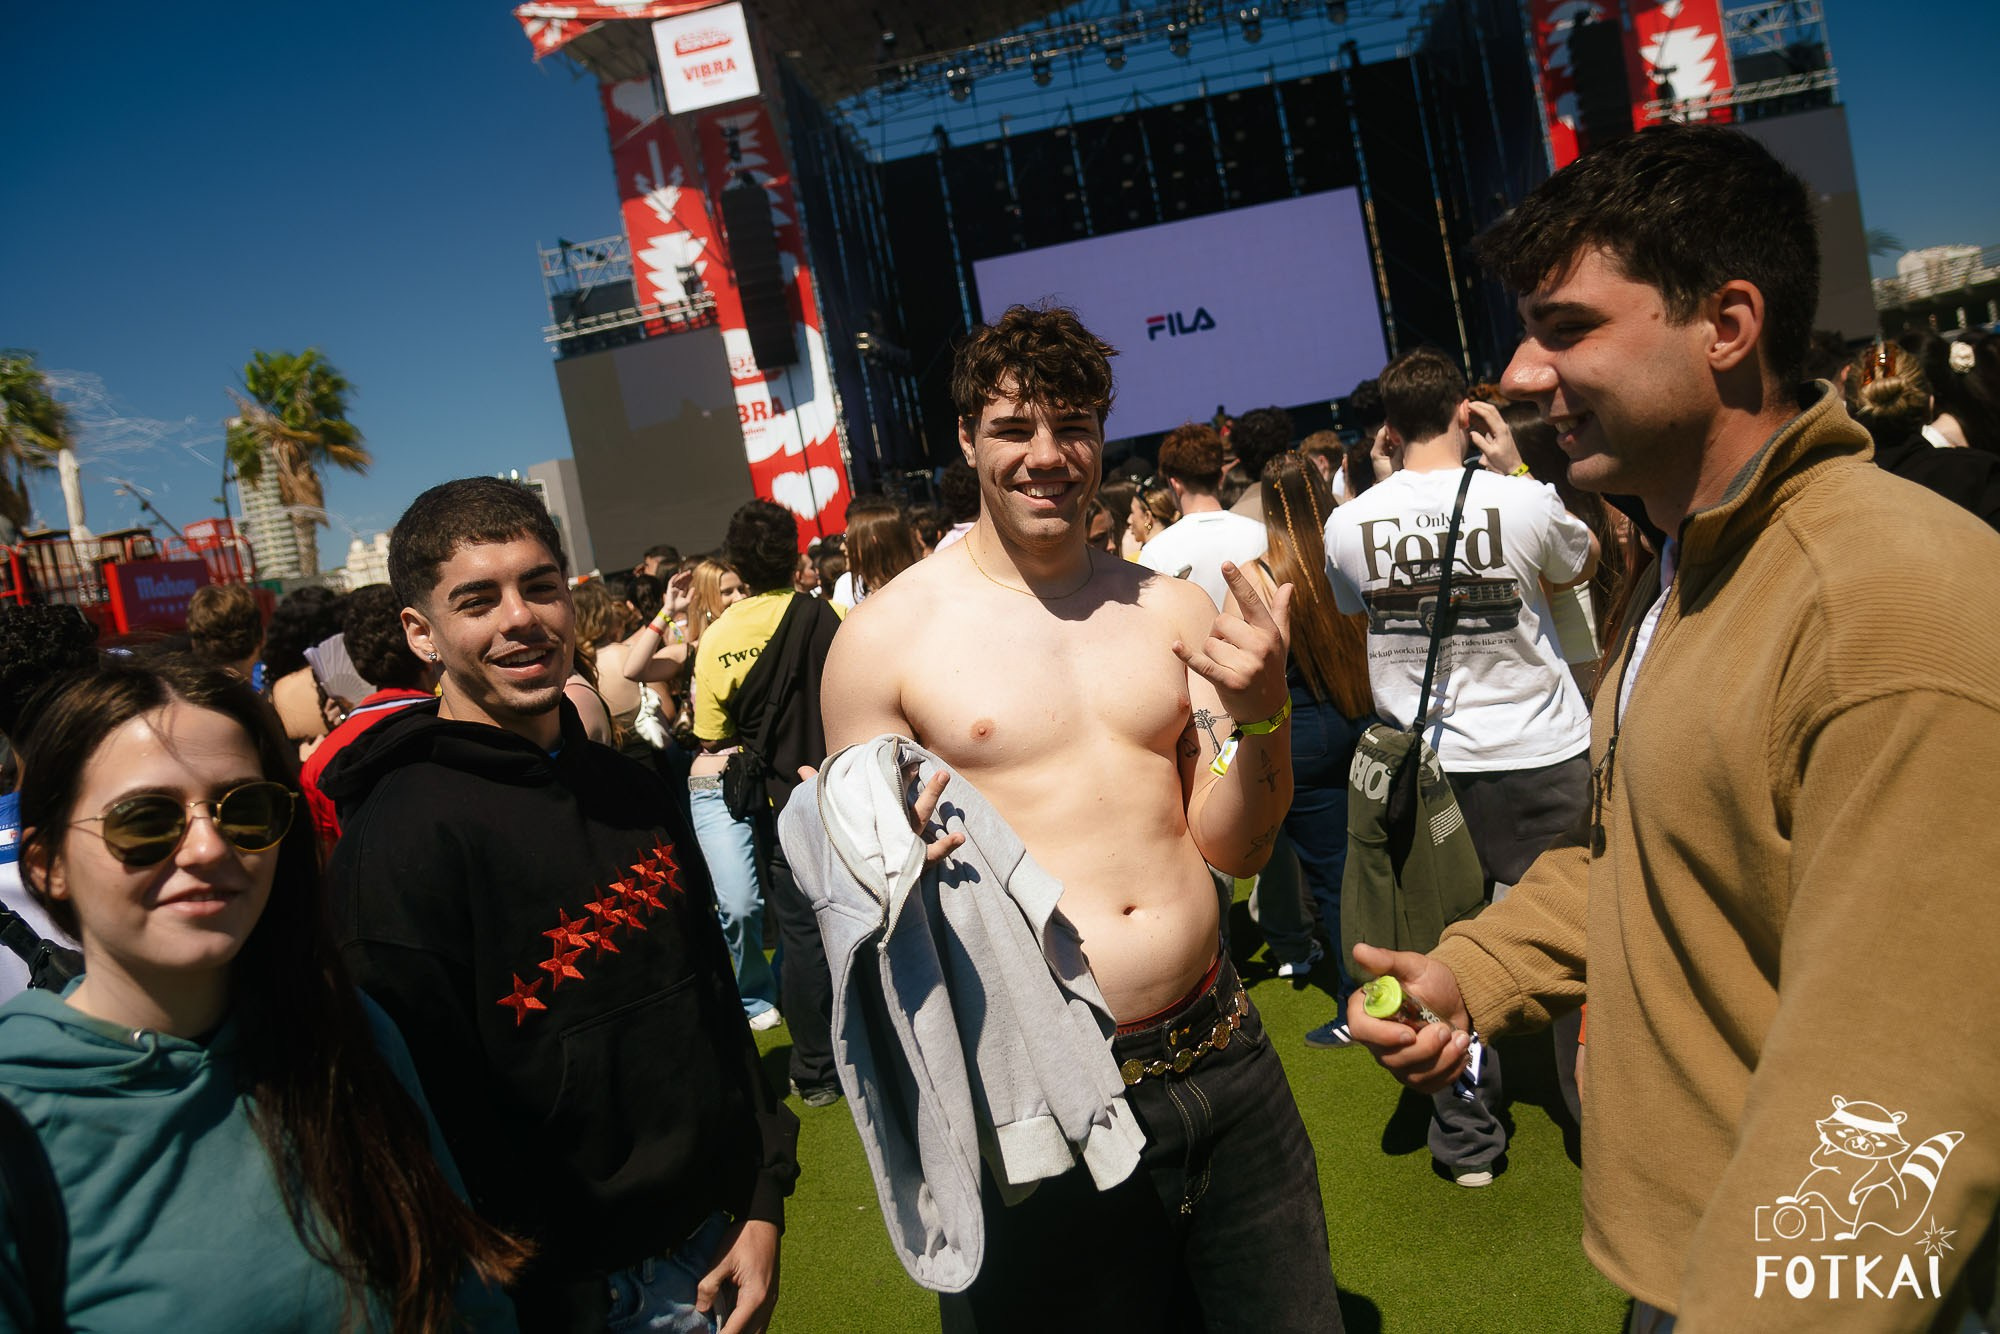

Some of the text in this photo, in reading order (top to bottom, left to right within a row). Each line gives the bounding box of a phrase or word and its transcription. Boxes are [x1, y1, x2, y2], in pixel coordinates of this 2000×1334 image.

[683, 57, 737, 81] VIBRA
[1146, 307, 1216, 341] FILA
[1358, 507, 1506, 582] Ford
[718, 640, 769, 669] Two
[1394, 647, 1415, 655] works
[1482, 638, 1497, 646] like
